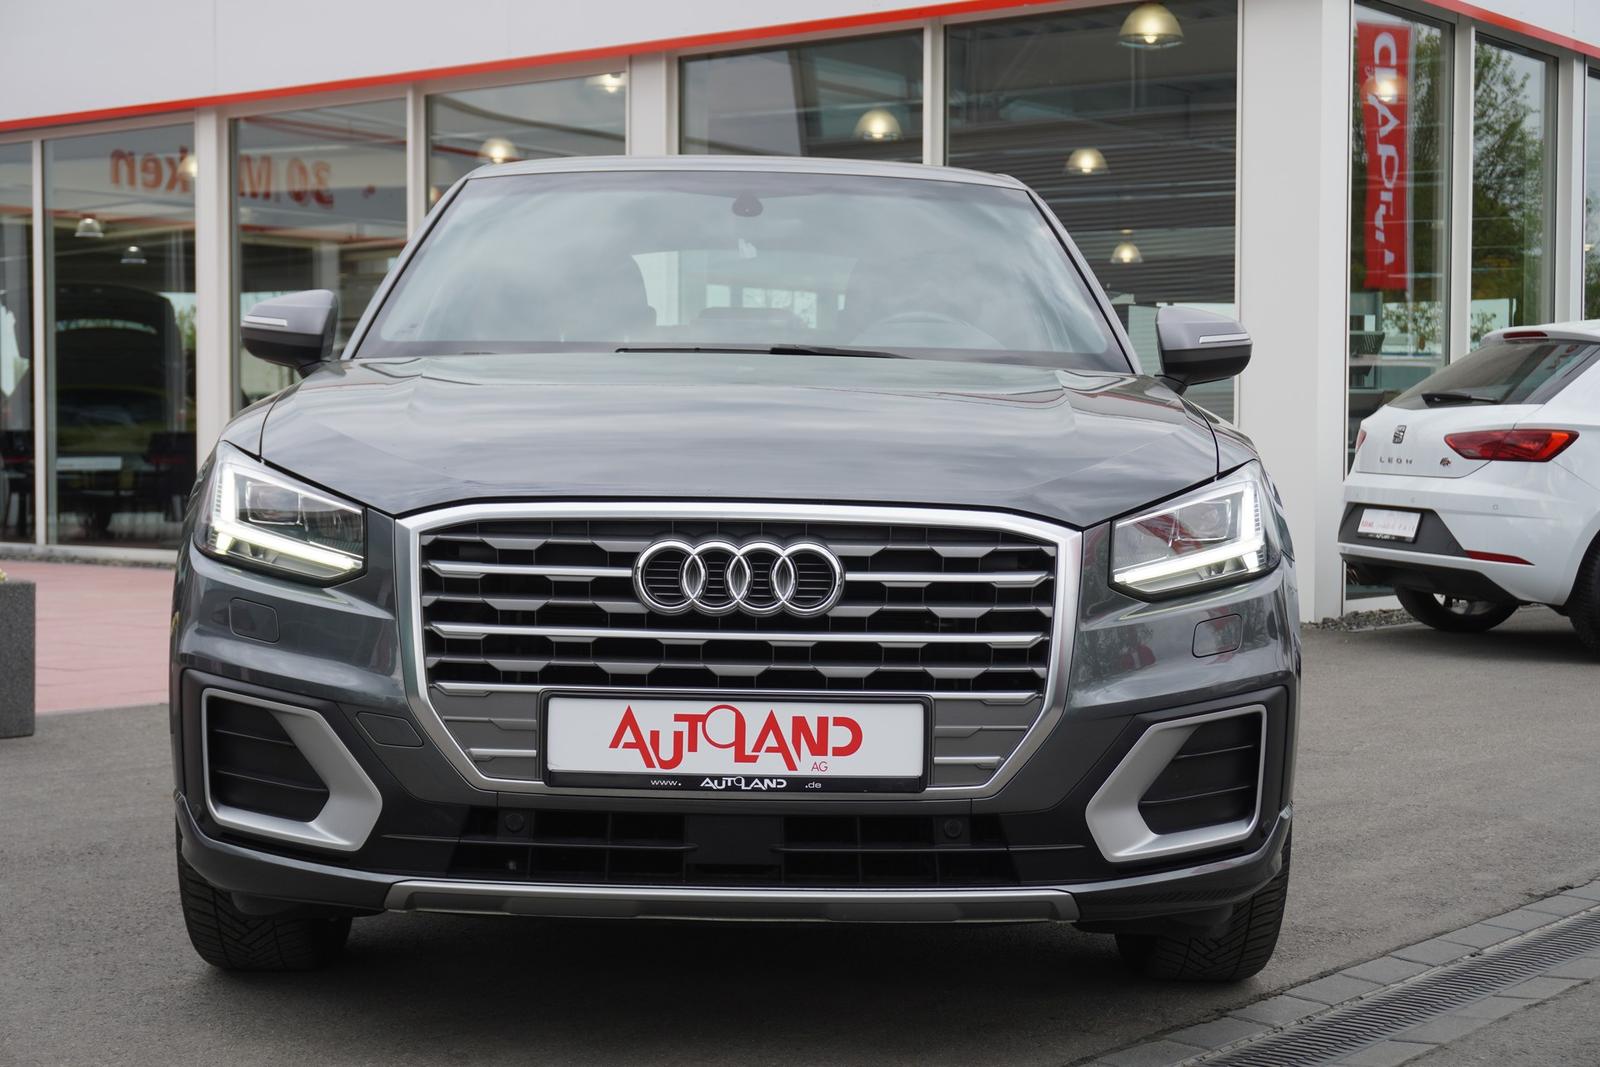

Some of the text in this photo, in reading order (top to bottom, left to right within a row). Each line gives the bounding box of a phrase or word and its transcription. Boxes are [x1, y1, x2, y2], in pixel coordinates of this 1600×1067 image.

[1379, 456, 1413, 465] LEON
[608, 704, 863, 772] AUTOLAND
[811, 761, 829, 772] AG
[700, 776, 787, 790] AUTOLAND
